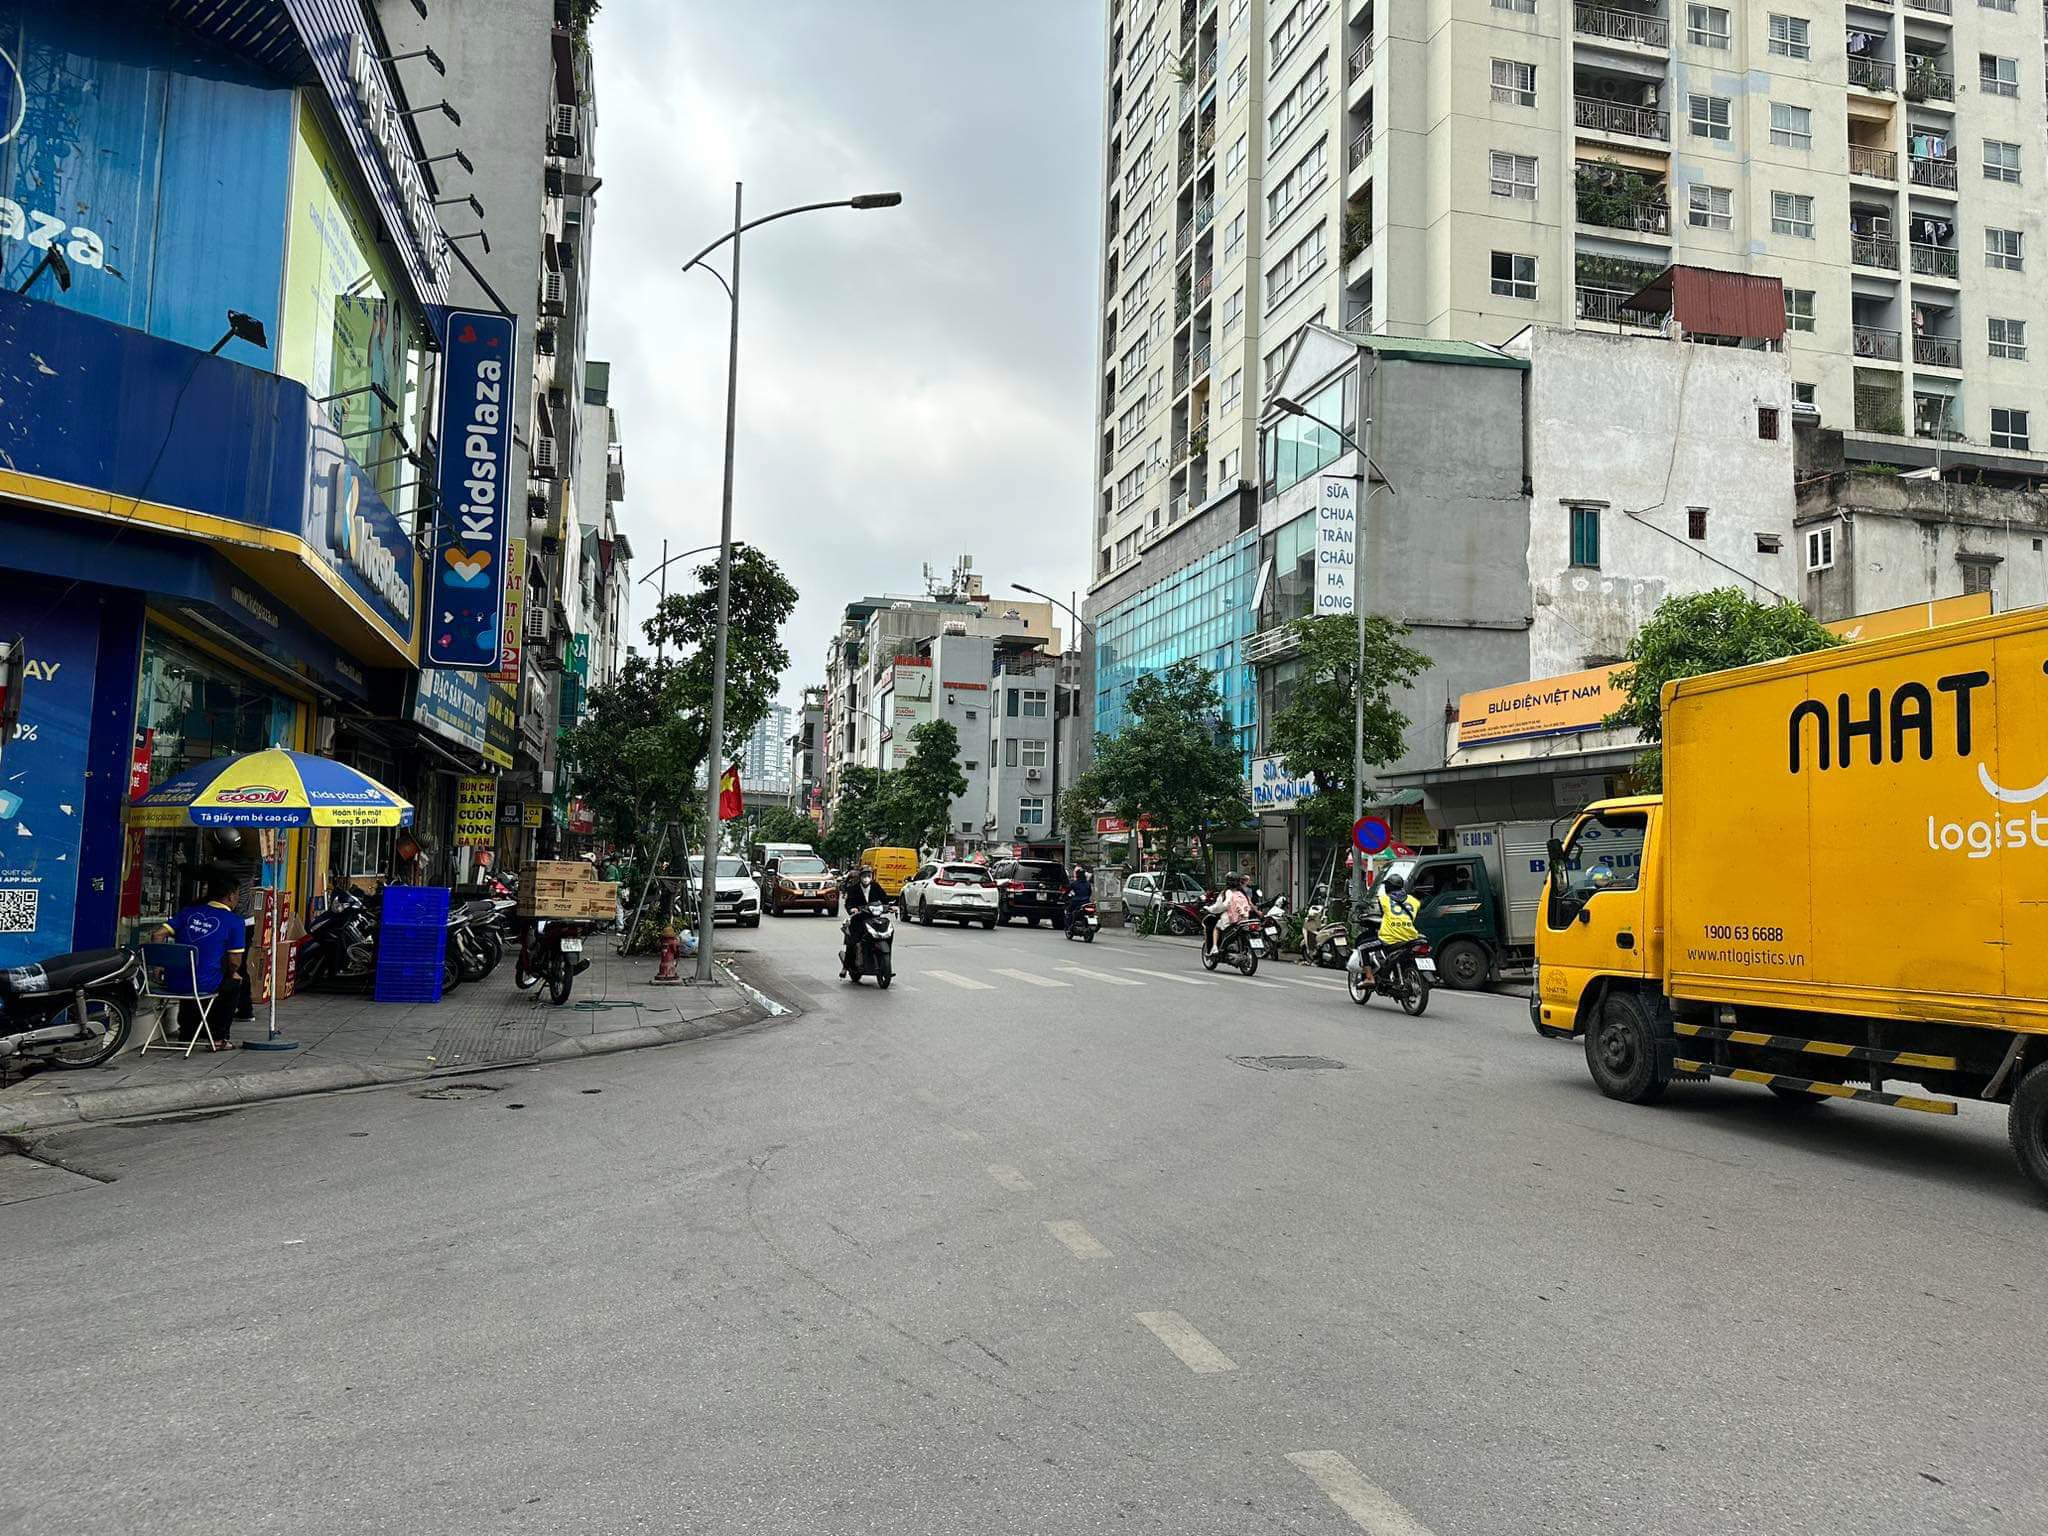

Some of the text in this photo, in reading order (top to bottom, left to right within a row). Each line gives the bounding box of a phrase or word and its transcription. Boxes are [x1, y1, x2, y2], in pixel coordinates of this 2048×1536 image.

[0, 196, 104, 270] aza
[461, 359, 501, 541] KidsPlaza
[1326, 483, 1349, 499] SỮA
[1320, 507, 1354, 521] CHUA
[1322, 527, 1353, 543] TRÂN
[1320, 549, 1354, 565] CHÂU
[1327, 573, 1345, 589] HẠ
[1319, 594, 1353, 609] LONG
[23, 659, 61, 682] AY
[1513, 693, 1541, 710] ĐIỆN
[1543, 687, 1570, 706] VIỆT
[1572, 685, 1601, 700] NAM
[213, 812, 234, 823] giấy
[251, 812, 264, 821] bé
[265, 814, 281, 822] cao
[282, 811, 299, 823] cấp
[458, 806, 493, 820] CUỐN
[457, 822, 492, 834] NÓNG
[1928, 809, 2048, 858] logist
[1703, 925, 1784, 942] 1900 63 6688
[1687, 948, 1805, 967] www.ntlogistics.vn
